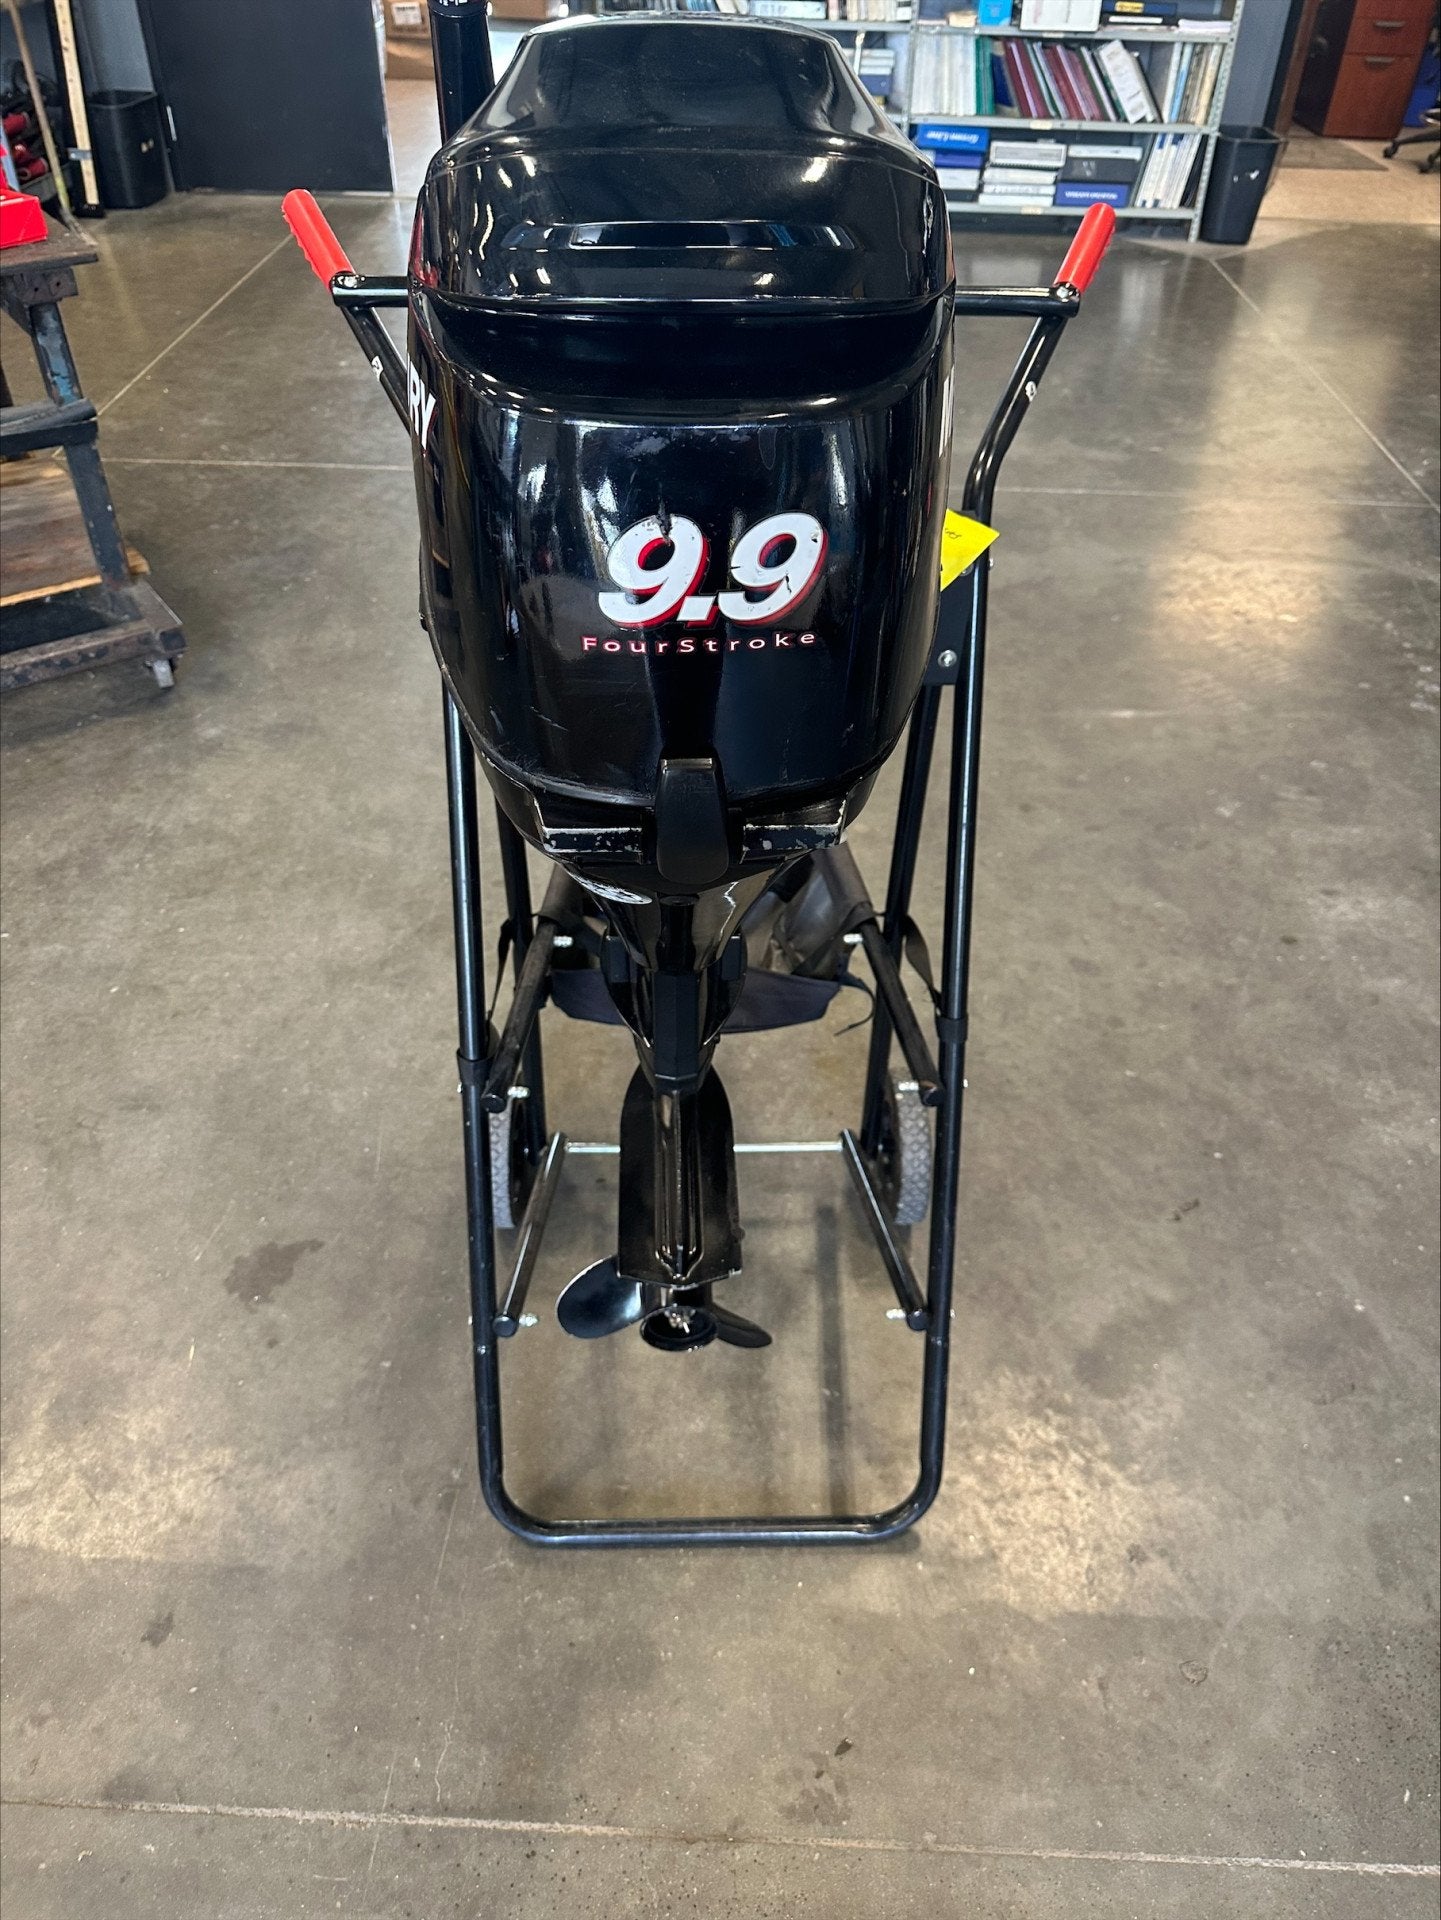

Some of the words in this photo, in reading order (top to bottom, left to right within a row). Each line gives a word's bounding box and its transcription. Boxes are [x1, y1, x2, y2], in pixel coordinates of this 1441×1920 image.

[406, 353, 437, 452] RY
[598, 511, 828, 630] 9.9
[581, 633, 816, 654] FourStroke
